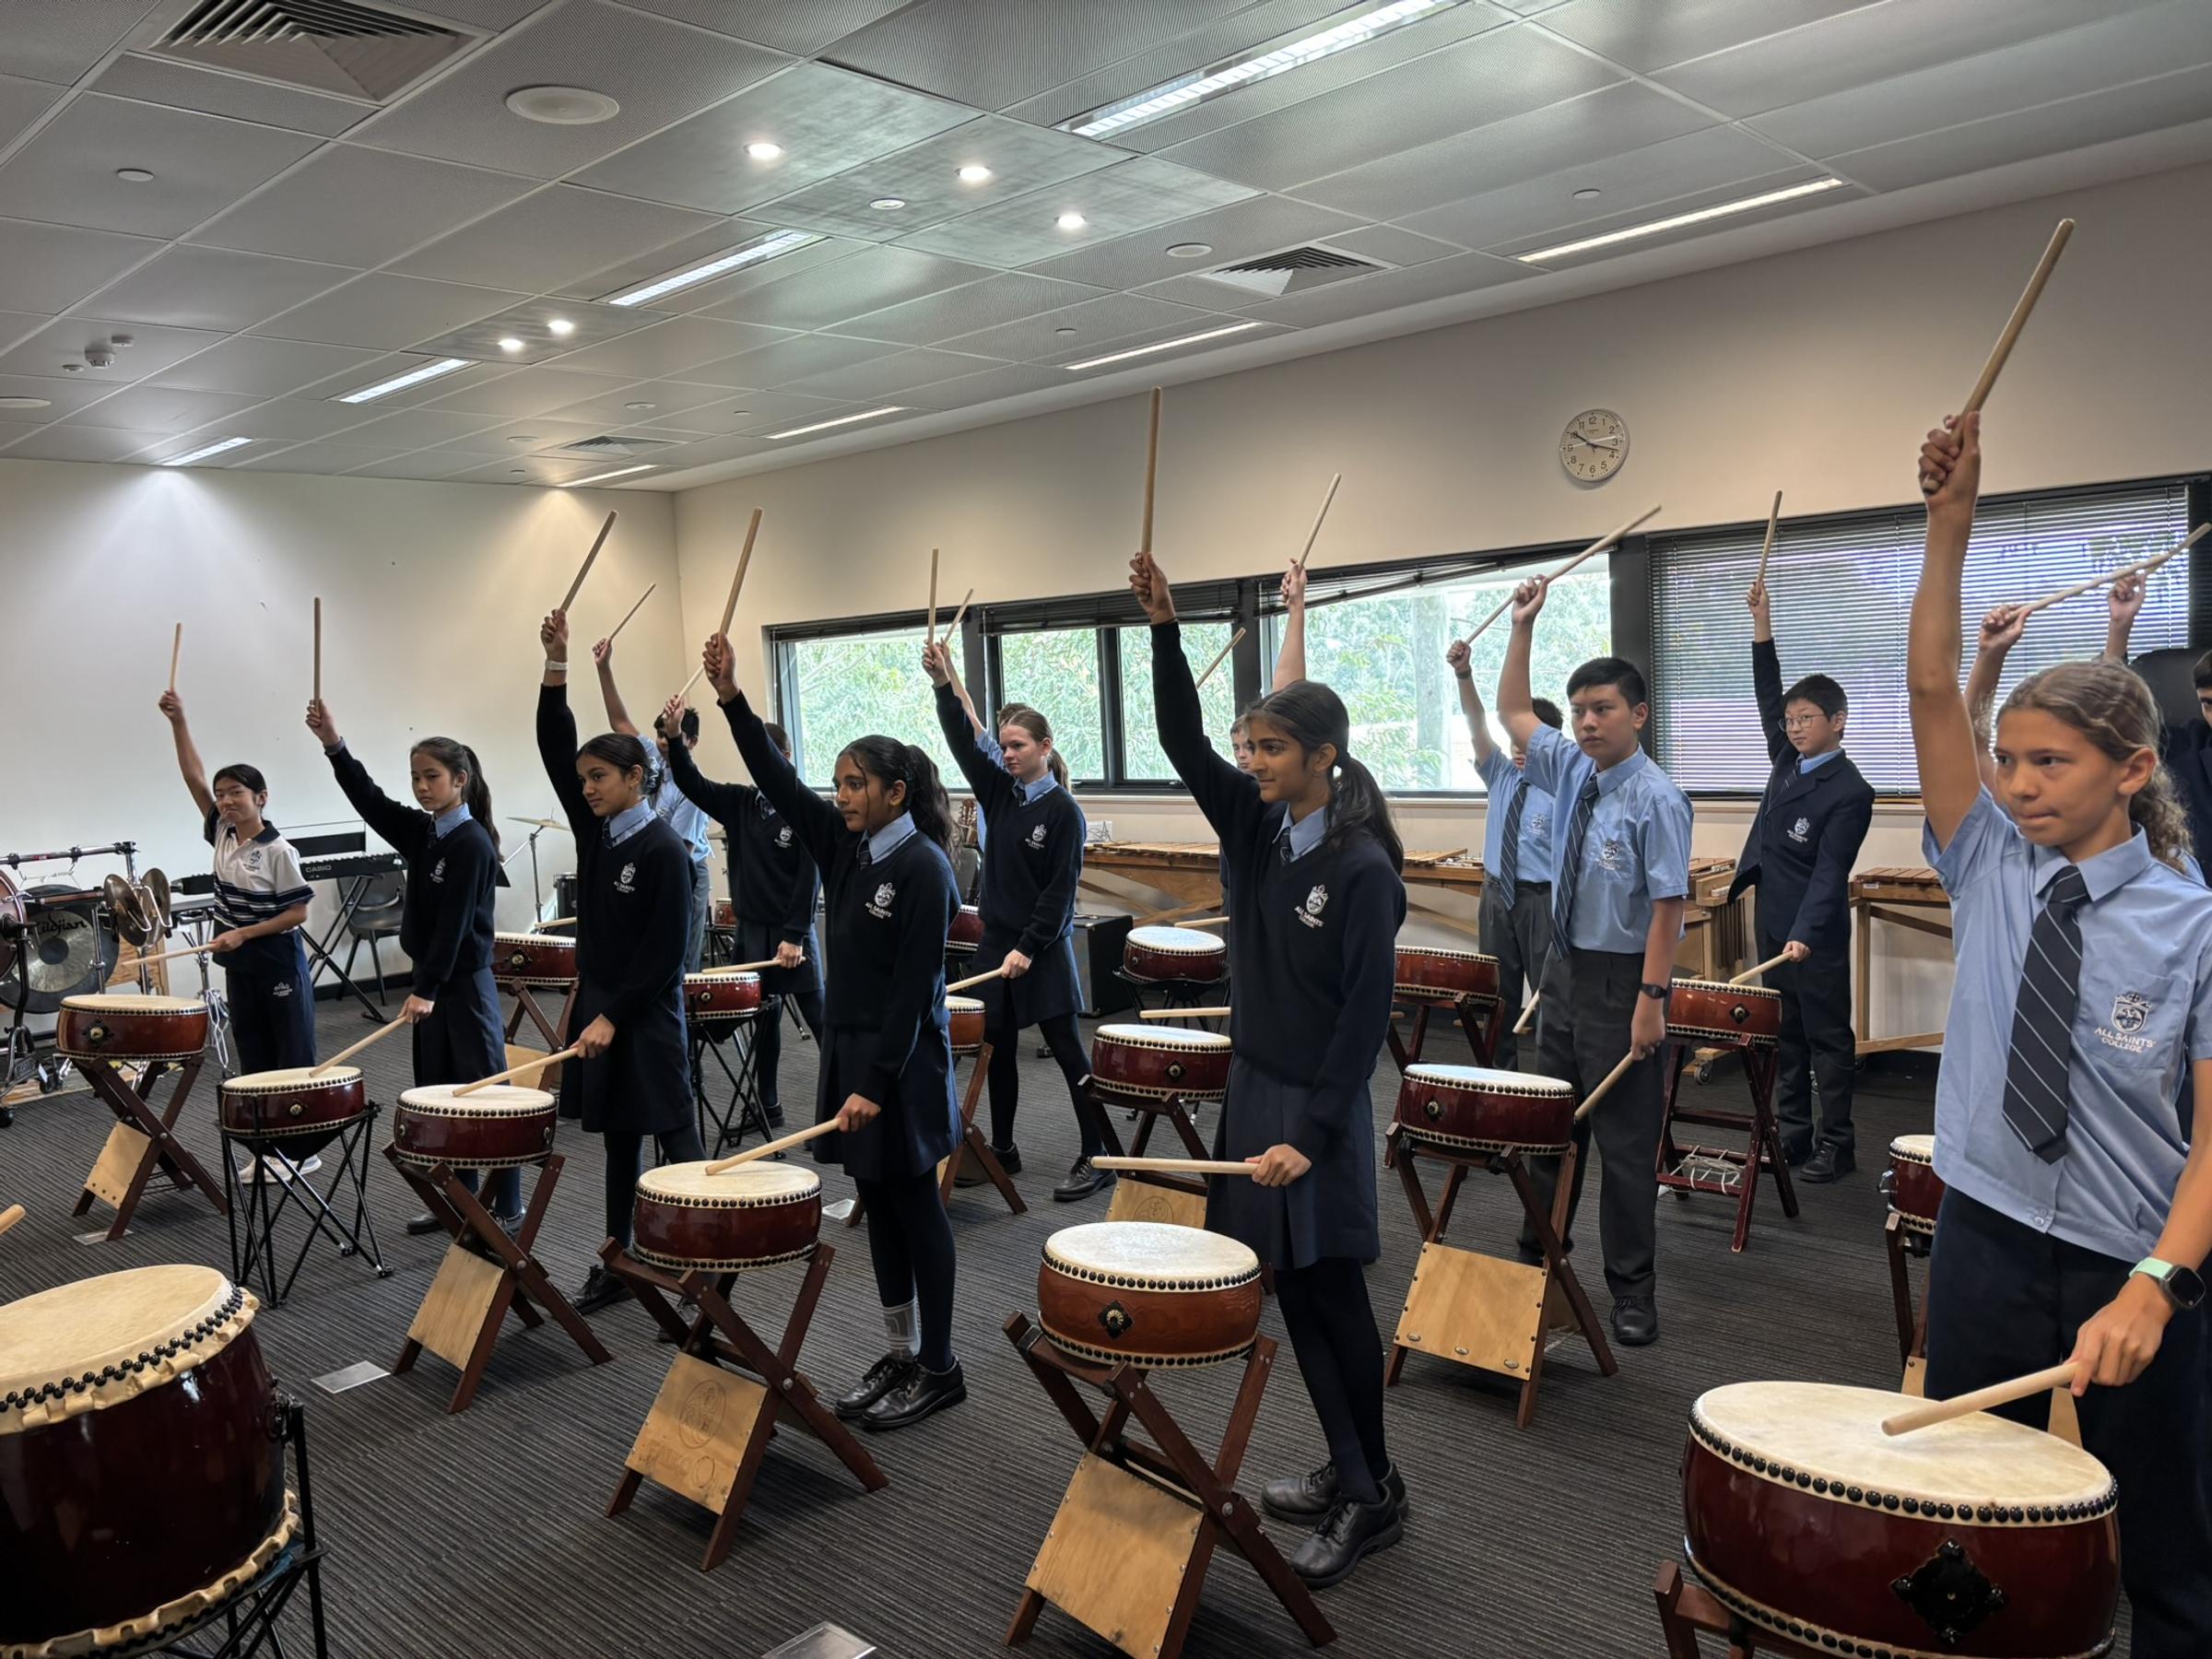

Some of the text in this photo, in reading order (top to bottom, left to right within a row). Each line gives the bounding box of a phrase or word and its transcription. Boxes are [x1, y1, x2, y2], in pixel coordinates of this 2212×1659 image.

[1588, 416, 1596, 424] 12
[1608, 426, 1615, 434] 2
[1612, 438, 1618, 446] 3
[1571, 456, 1576, 465] 8
[1579, 464, 1584, 472] 7
[1590, 465, 1595, 474] 6
[1600, 461, 1606, 470] 5
[305, 865, 332, 873] CASIO
[2094, 1027, 2113, 1039] ALL
[2101, 1037, 2142, 1053] COLLEGE
